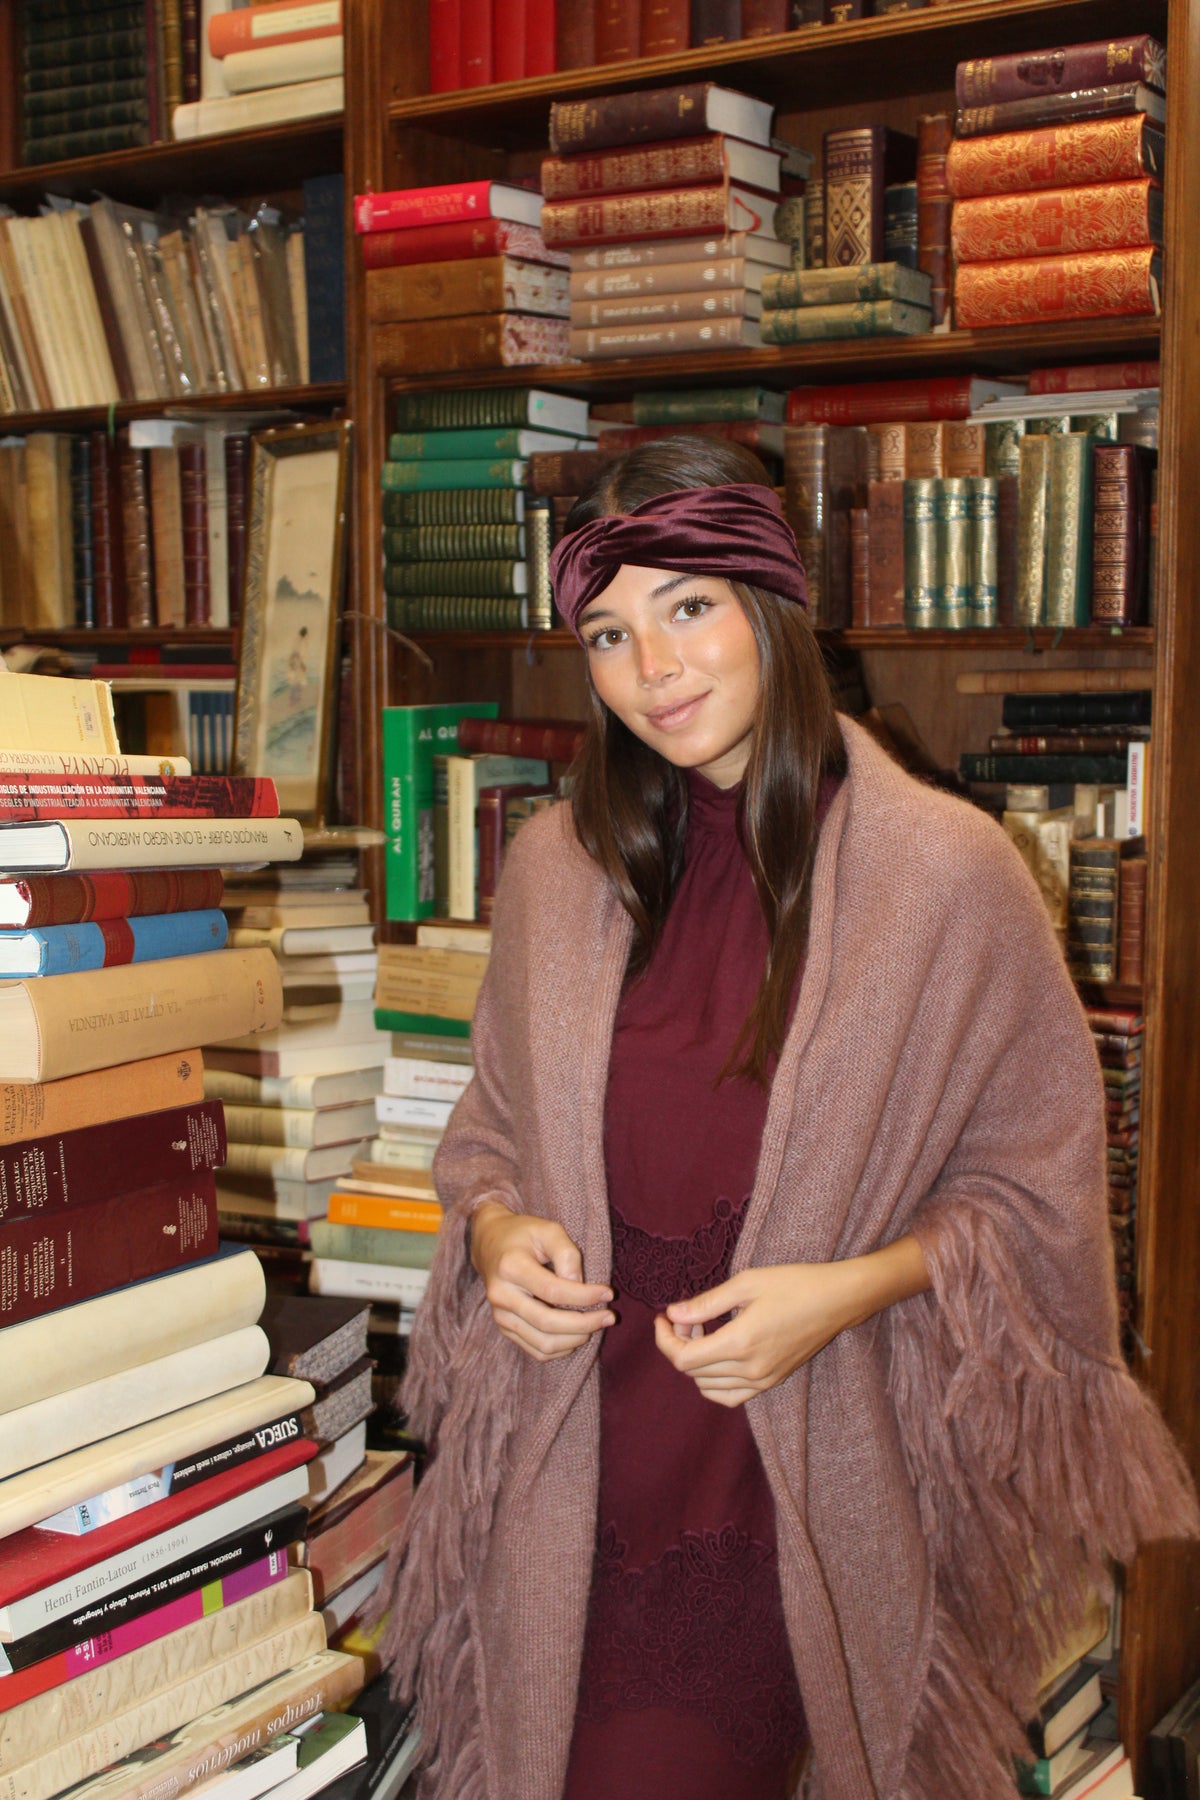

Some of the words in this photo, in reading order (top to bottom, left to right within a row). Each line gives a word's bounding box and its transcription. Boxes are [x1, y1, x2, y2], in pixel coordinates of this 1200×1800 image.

[19, 785, 28, 794] DE
[29, 784, 85, 794] INDUSTRIALIZACIÓN
[86, 786, 94, 794] EN
[94, 786, 103, 794] LA
[103, 786, 133, 794] COMUNITAT
[134, 786, 167, 795] VALENCIANA
[99, 799, 130, 807] COMUNITAT
[131, 799, 163, 807] VALENCIANA
[392, 777, 402, 830] QURAN
[88, 832, 140, 846] AMERICANO
[144, 832, 173, 845] NEGRO
[29, 1151, 33, 1162] DE
[14, 1162, 22, 1202] CATÀLEG
[40, 1151, 48, 1200] VALENCIANA
[0, 1160, 8, 1210] VALENCIANA
[24, 1157, 32, 1208] MONUMENTS
[38, 1197, 43, 1207] LA
[38, 1241, 43, 1252] DE
[1, 1249, 6, 1260] DE
[45, 1286, 50, 1296] LA
[7, 1300, 12, 1310] LA
[255, 1418, 298, 1448] SUECA
[213, 1449, 232, 1462] cultura
[196, 1459, 210, 1471] medi
[173, 1464, 196, 1480] ambient
[191, 1562, 209, 1574] ISABEL
[169, 1570, 191, 1584] GUERRA
[44, 1592, 72, 1612] Henri
[75, 1560, 137, 1597] Fantin-Latour
[109, 1597, 128, 1610] dibujo
[267, 1694, 322, 1736] Tiempos
[189, 1729, 261, 1782] modernos
